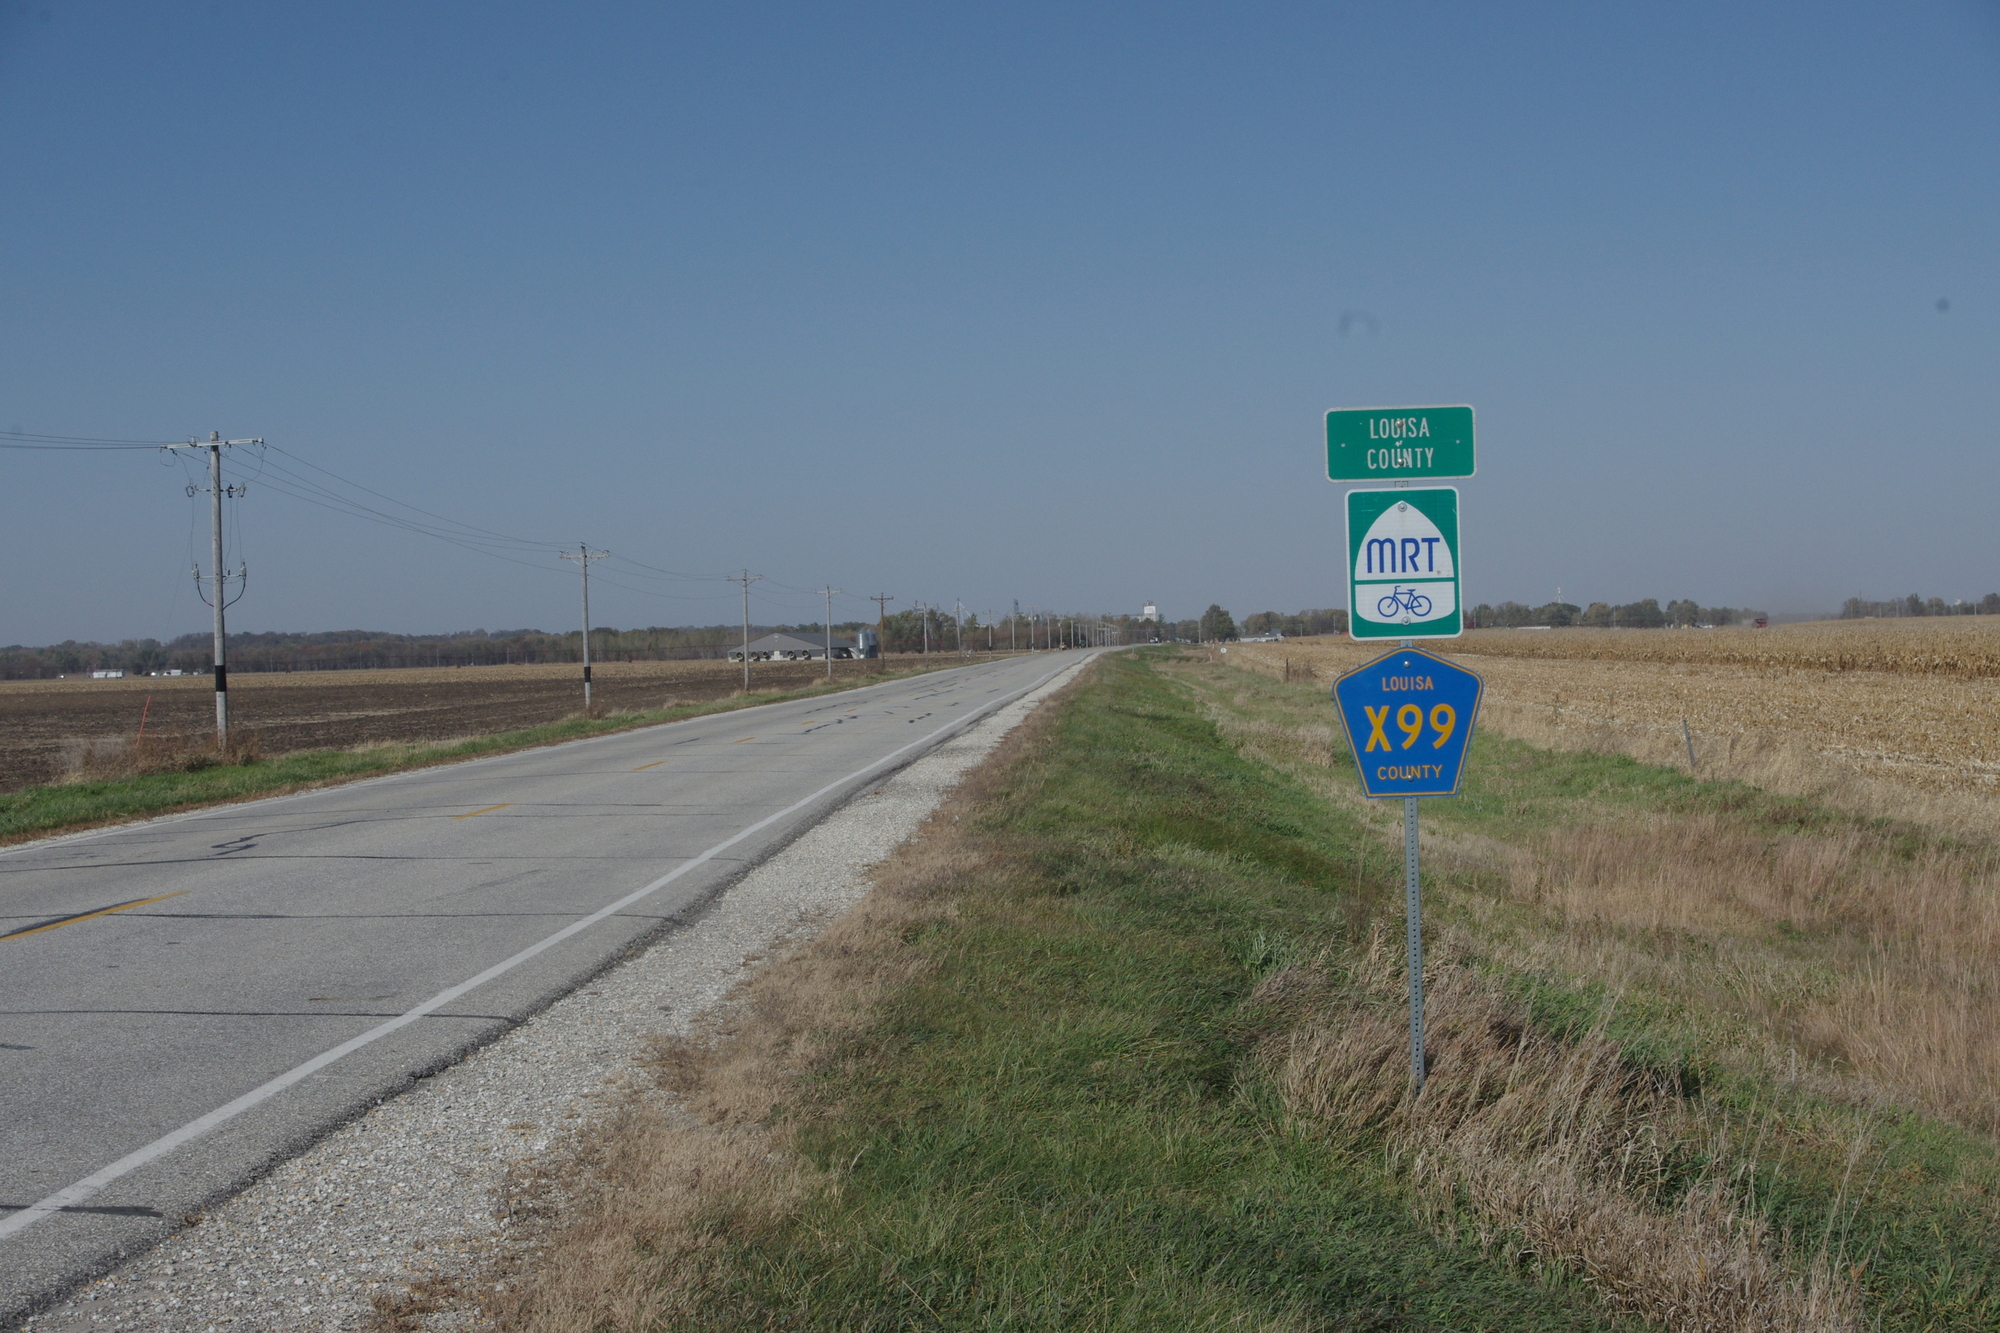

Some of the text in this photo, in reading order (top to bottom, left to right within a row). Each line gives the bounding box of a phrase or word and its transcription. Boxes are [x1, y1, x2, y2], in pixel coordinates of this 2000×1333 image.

[1369, 417, 1430, 439] LOUISA
[1367, 447, 1434, 470] COUNTY
[1366, 537, 1441, 573] MRT
[1382, 676, 1434, 691] LOUISA
[1364, 703, 1456, 752] X99
[1377, 764, 1442, 780] COUNTY
